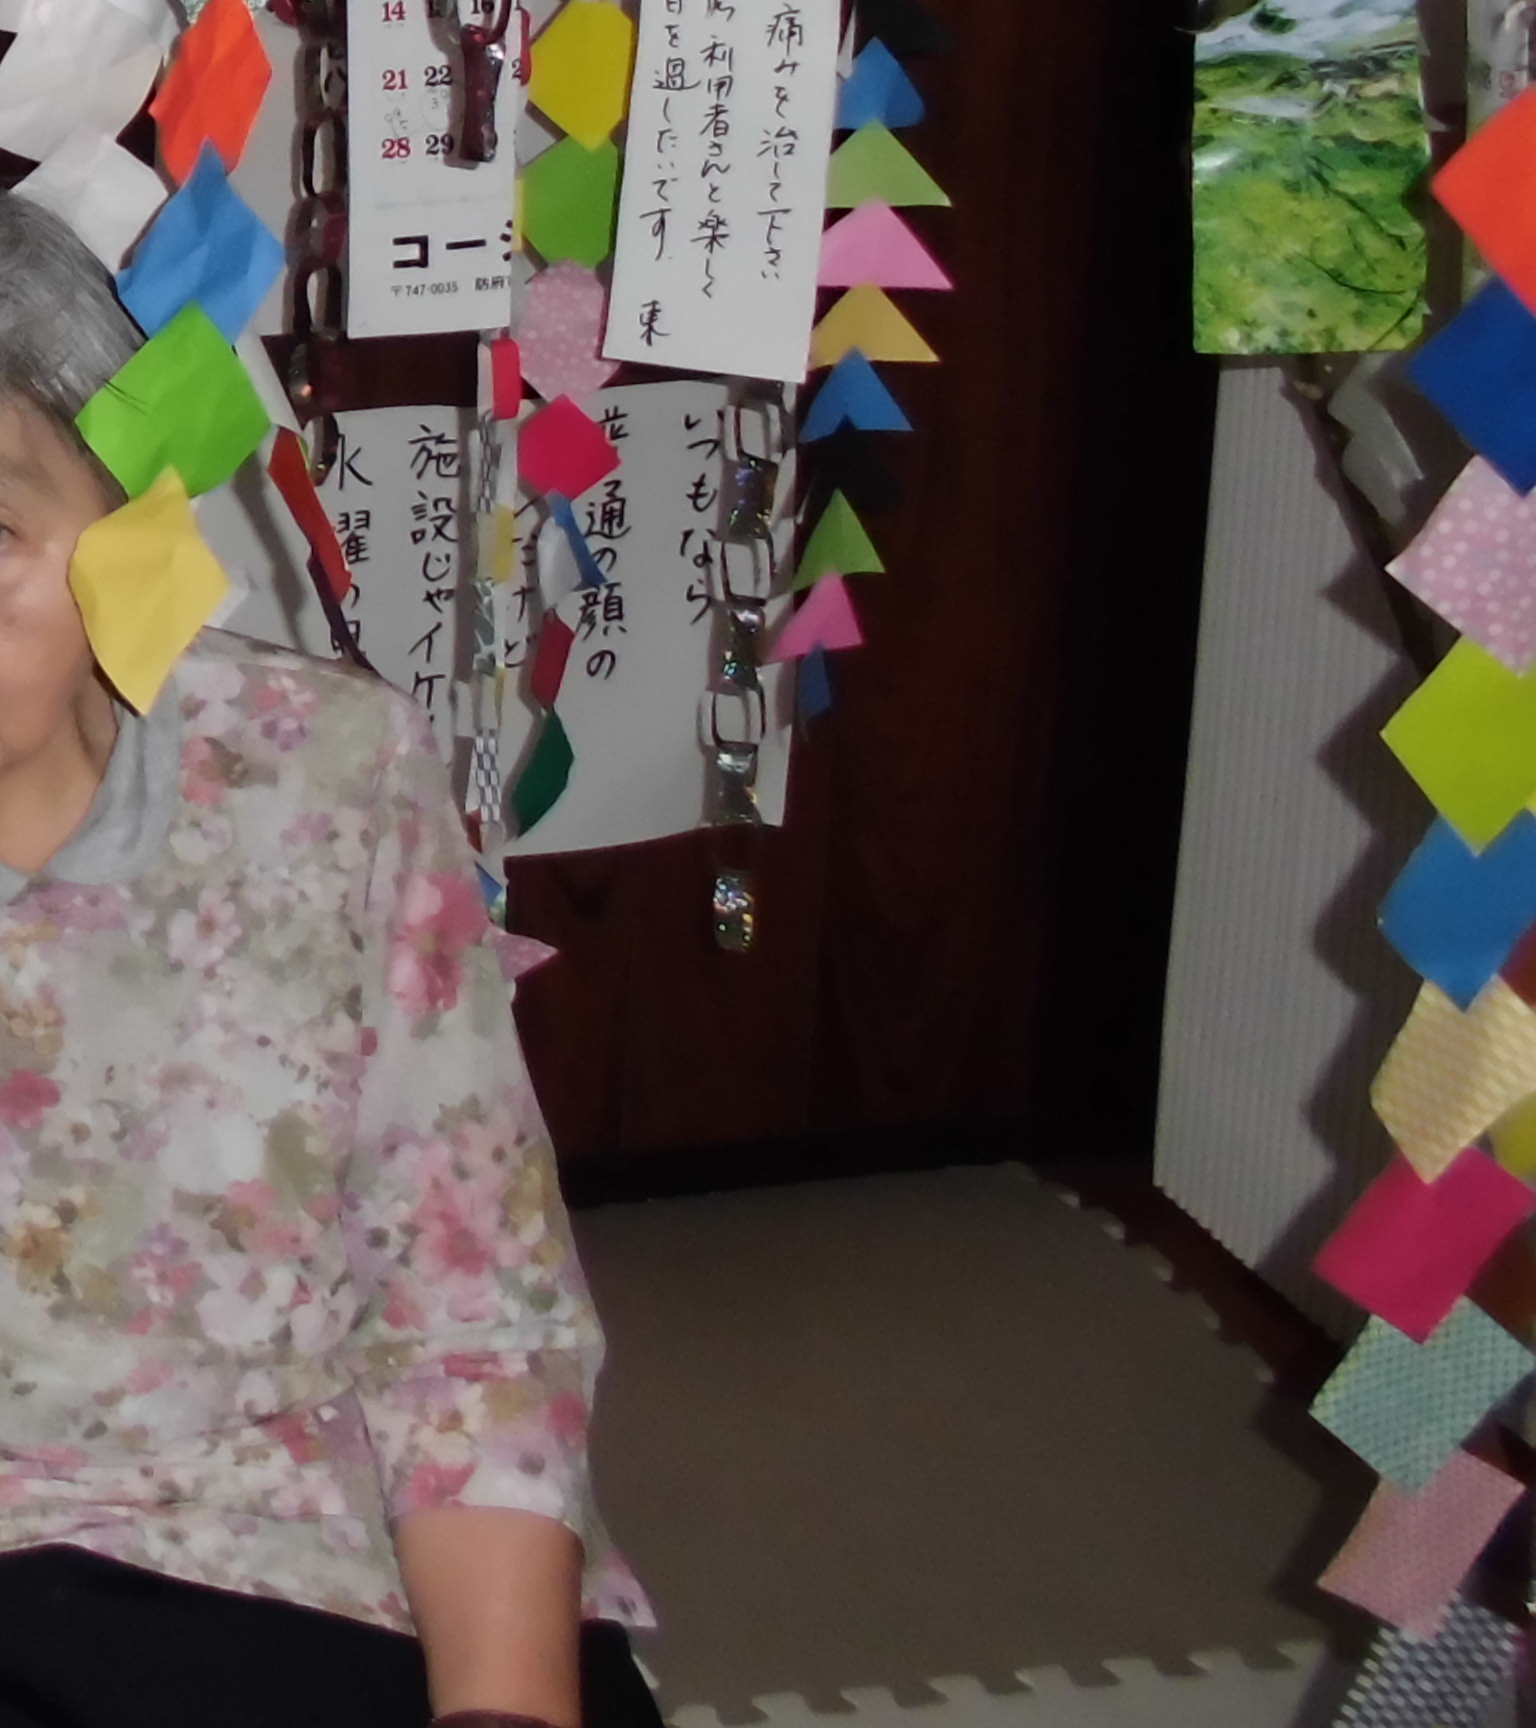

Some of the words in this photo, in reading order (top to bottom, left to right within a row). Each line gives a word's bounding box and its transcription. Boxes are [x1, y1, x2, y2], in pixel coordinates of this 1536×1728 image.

[382, 0, 407, 22] 14
[382, 69, 408, 91] 21
[424, 65, 453, 87] 22
[382, 138, 411, 159] 28
[425, 134, 454, 156] 29
[680, 409, 726, 626] いつもなら
[408, 424, 459, 724] 施設じゃイケ
